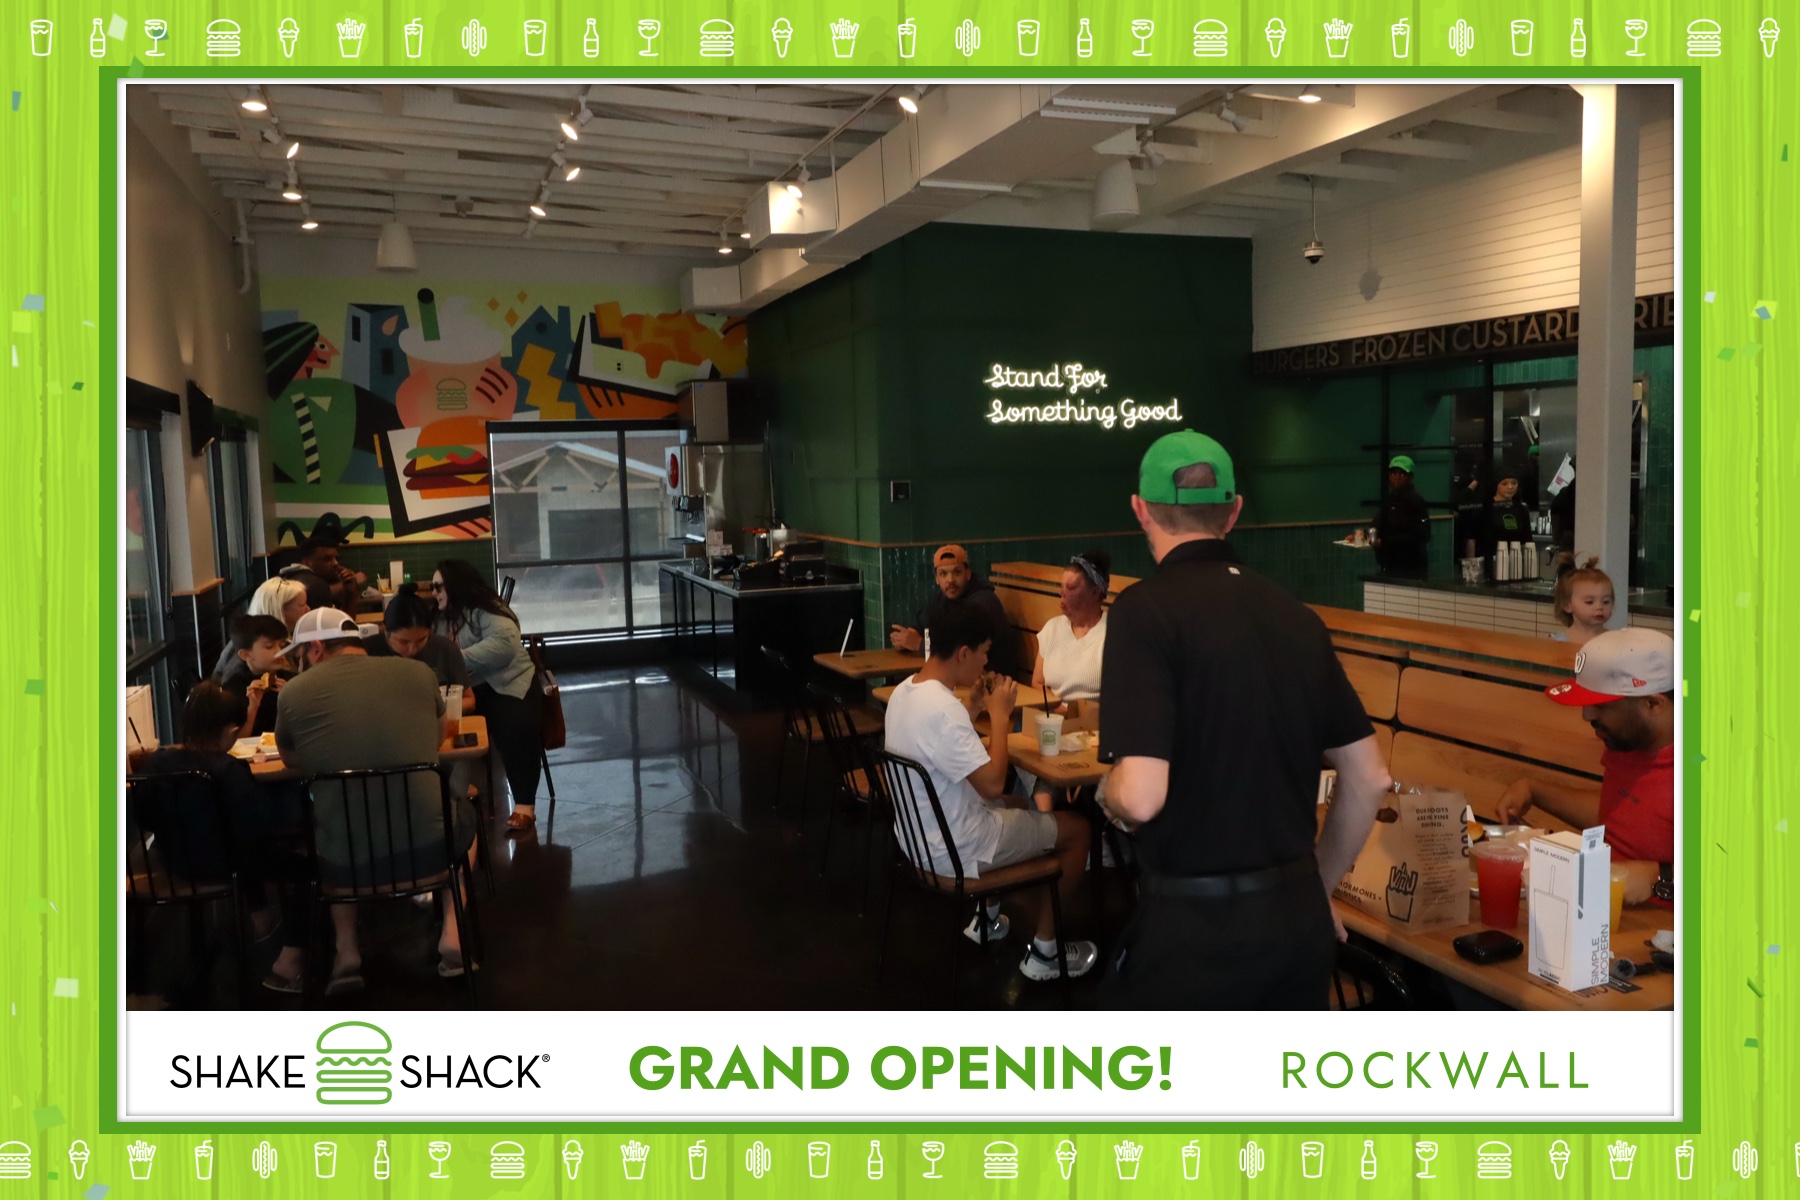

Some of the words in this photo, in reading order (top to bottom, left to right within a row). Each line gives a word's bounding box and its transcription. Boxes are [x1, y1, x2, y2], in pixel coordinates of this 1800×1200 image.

[1254, 342, 1340, 374] BURGERS
[1351, 327, 1446, 364] FROZEN
[1452, 308, 1580, 351] CUSTARD
[984, 363, 1065, 389] Stand
[1063, 363, 1108, 394] For
[986, 398, 1118, 430] Something
[1120, 397, 1183, 430] Good
[1591, 937, 1601, 986] SIMPLE
[1600, 924, 1609, 983] MODERN
